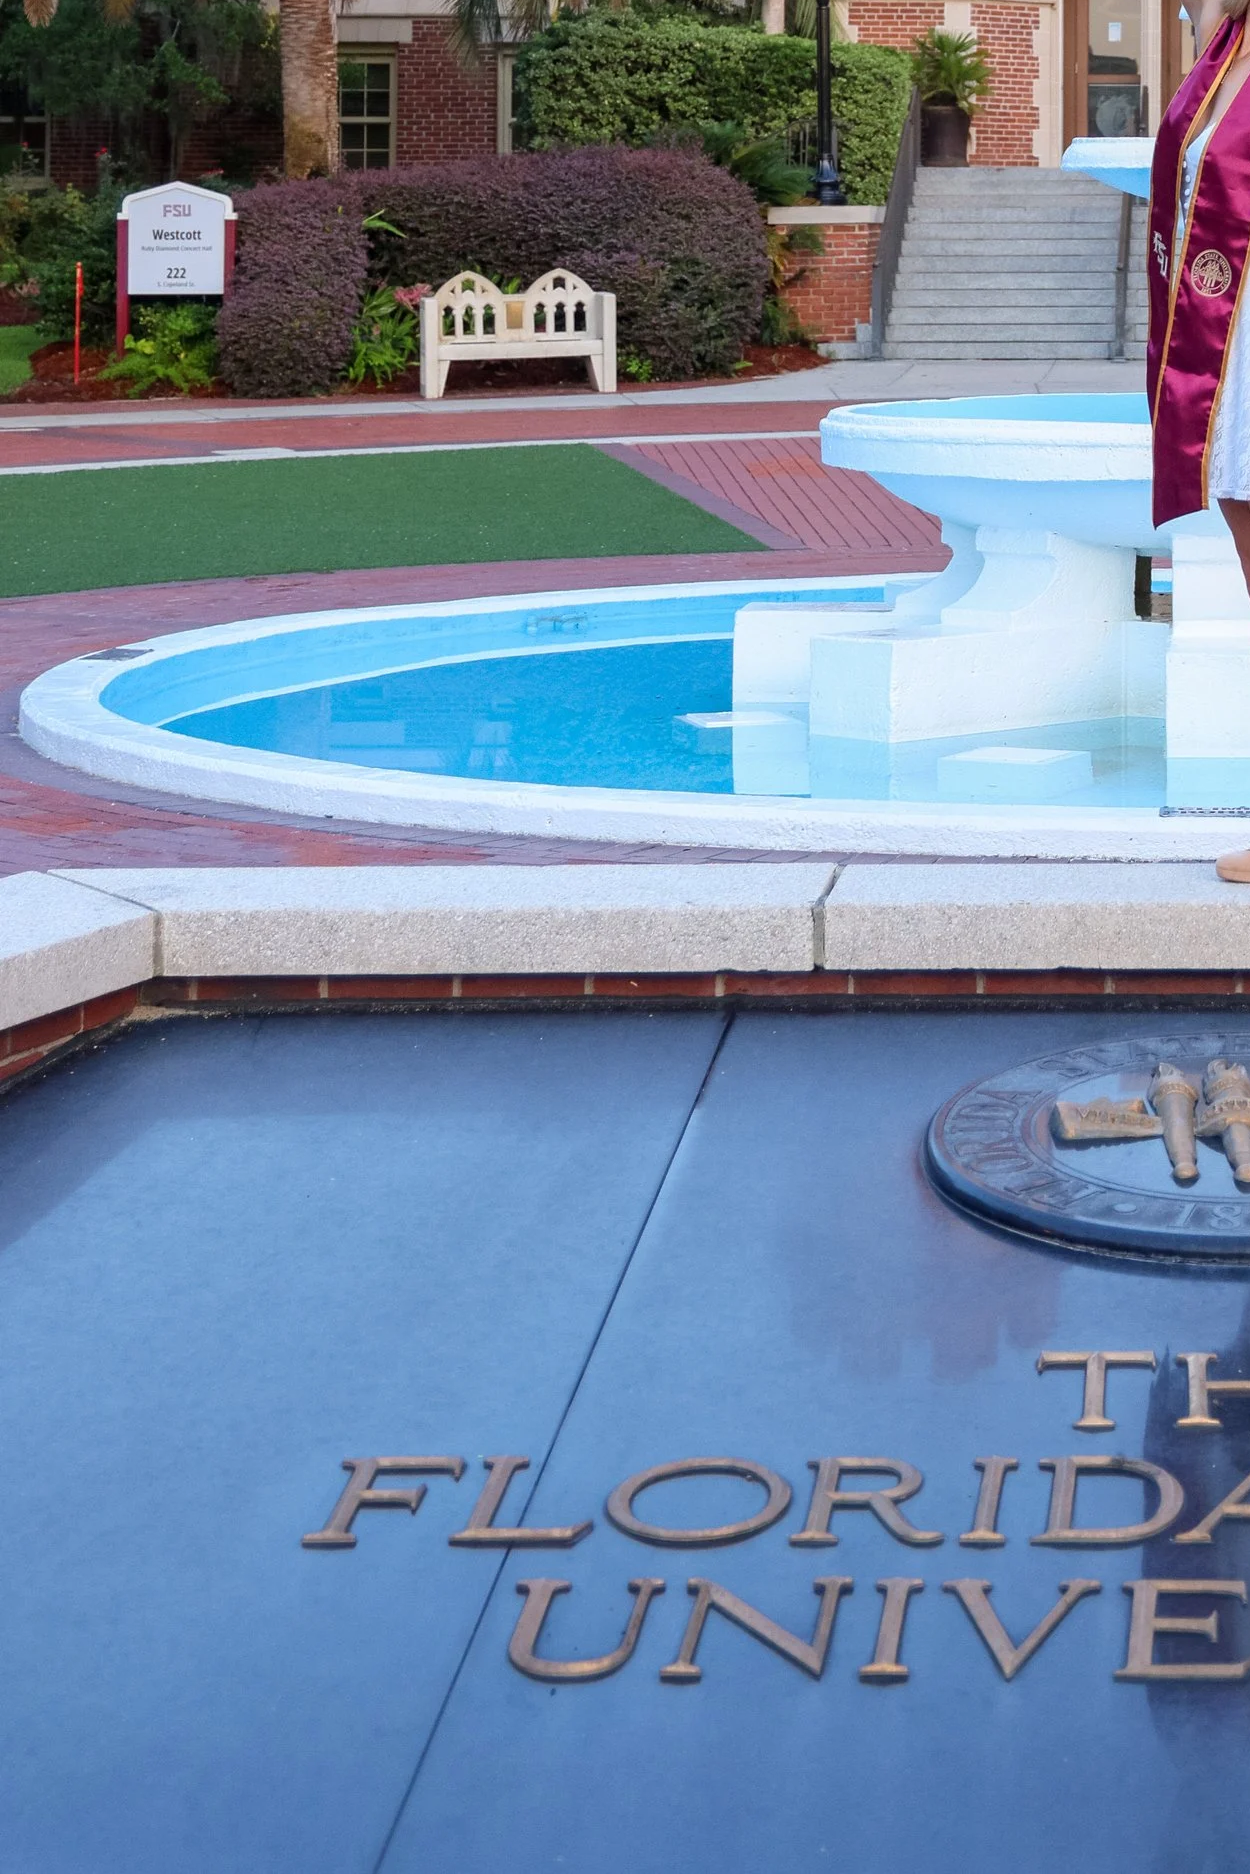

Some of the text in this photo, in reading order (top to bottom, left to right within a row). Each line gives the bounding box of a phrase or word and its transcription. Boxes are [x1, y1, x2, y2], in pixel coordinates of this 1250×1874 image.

[163, 204, 192, 217] FSU
[152, 229, 202, 240] Westcott
[1153, 231, 1169, 278] FSU
[166, 267, 187, 279] 222
[948, 1089, 1108, 1210] FLORIDA
